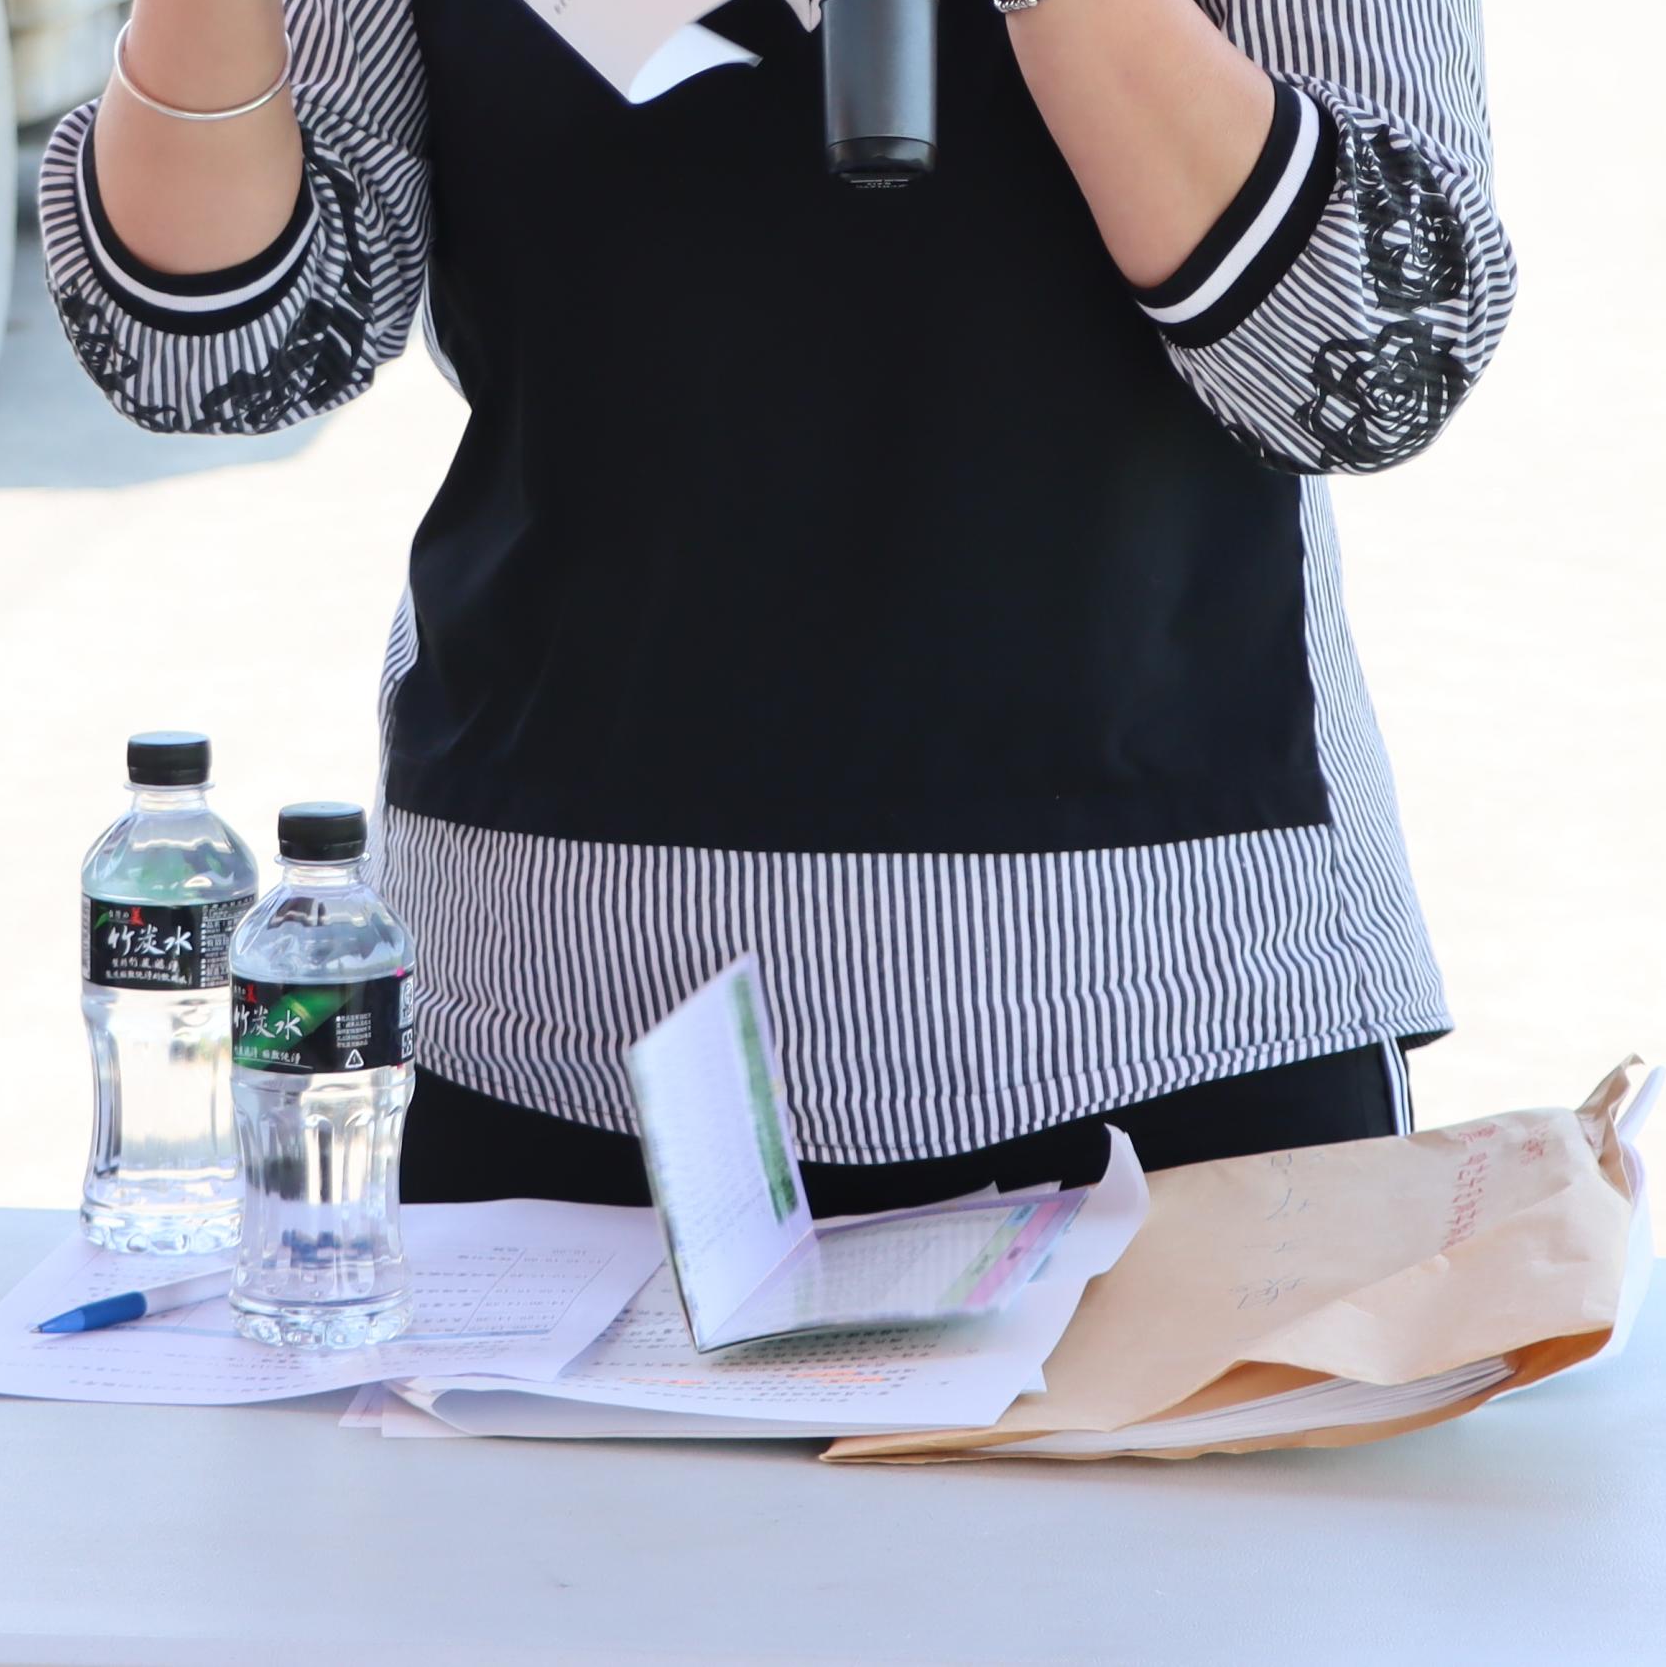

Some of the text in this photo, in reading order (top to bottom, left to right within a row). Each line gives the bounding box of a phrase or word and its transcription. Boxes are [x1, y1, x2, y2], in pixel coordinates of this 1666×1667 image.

[107, 923, 193, 957] 竹炭水
[234, 1004, 303, 1041] 竹炭水
